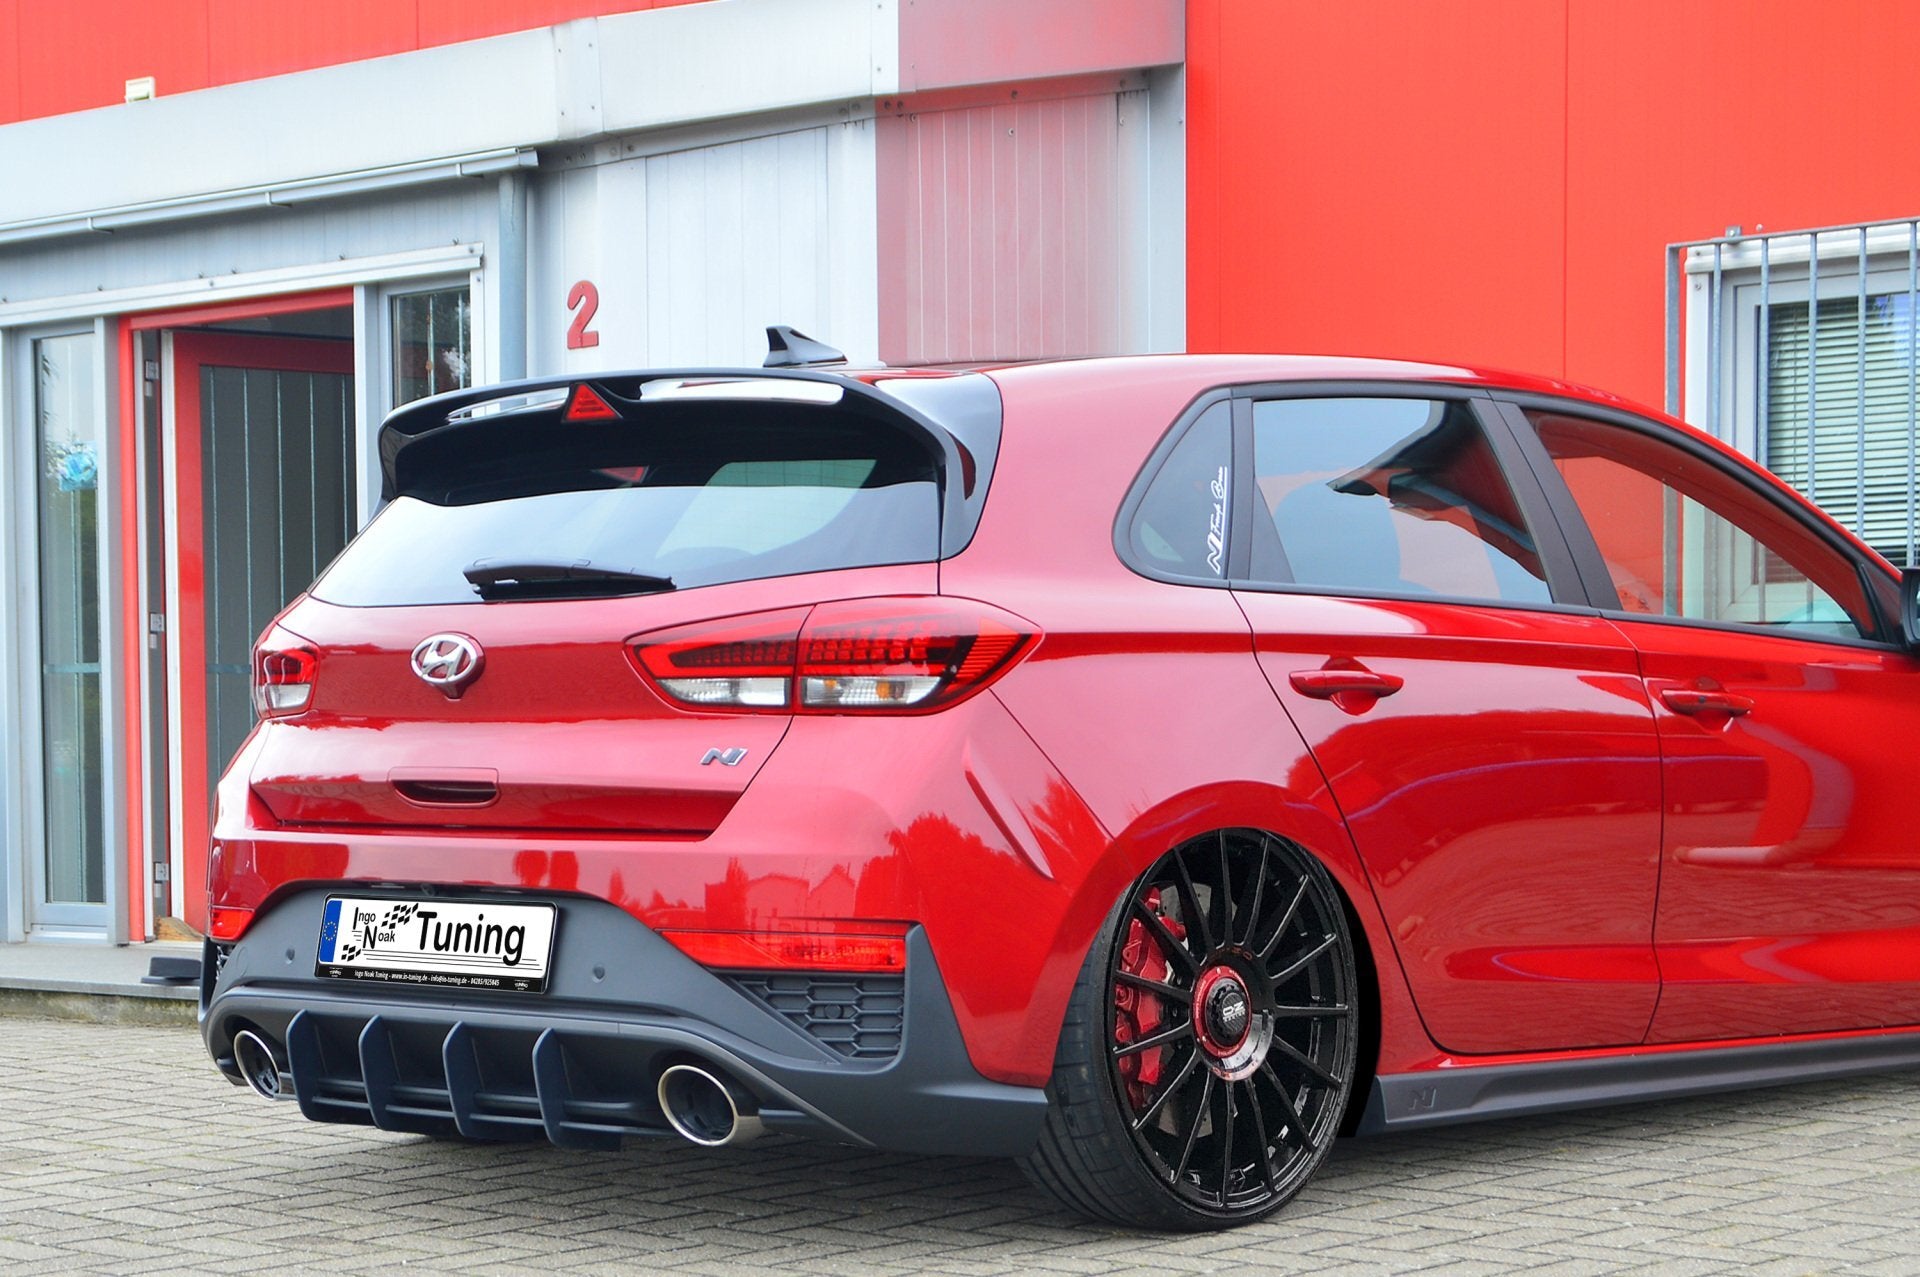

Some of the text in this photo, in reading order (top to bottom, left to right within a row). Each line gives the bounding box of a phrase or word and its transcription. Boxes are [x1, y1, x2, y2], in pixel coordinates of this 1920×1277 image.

[567, 280, 599, 350] 2
[353, 907, 376, 930] Ingo
[363, 925, 395, 949] Noak
[416, 911, 525, 966] Tuning
[375, 971, 388, 980] Tuning
[1222, 1000, 1244, 1017] OZ
